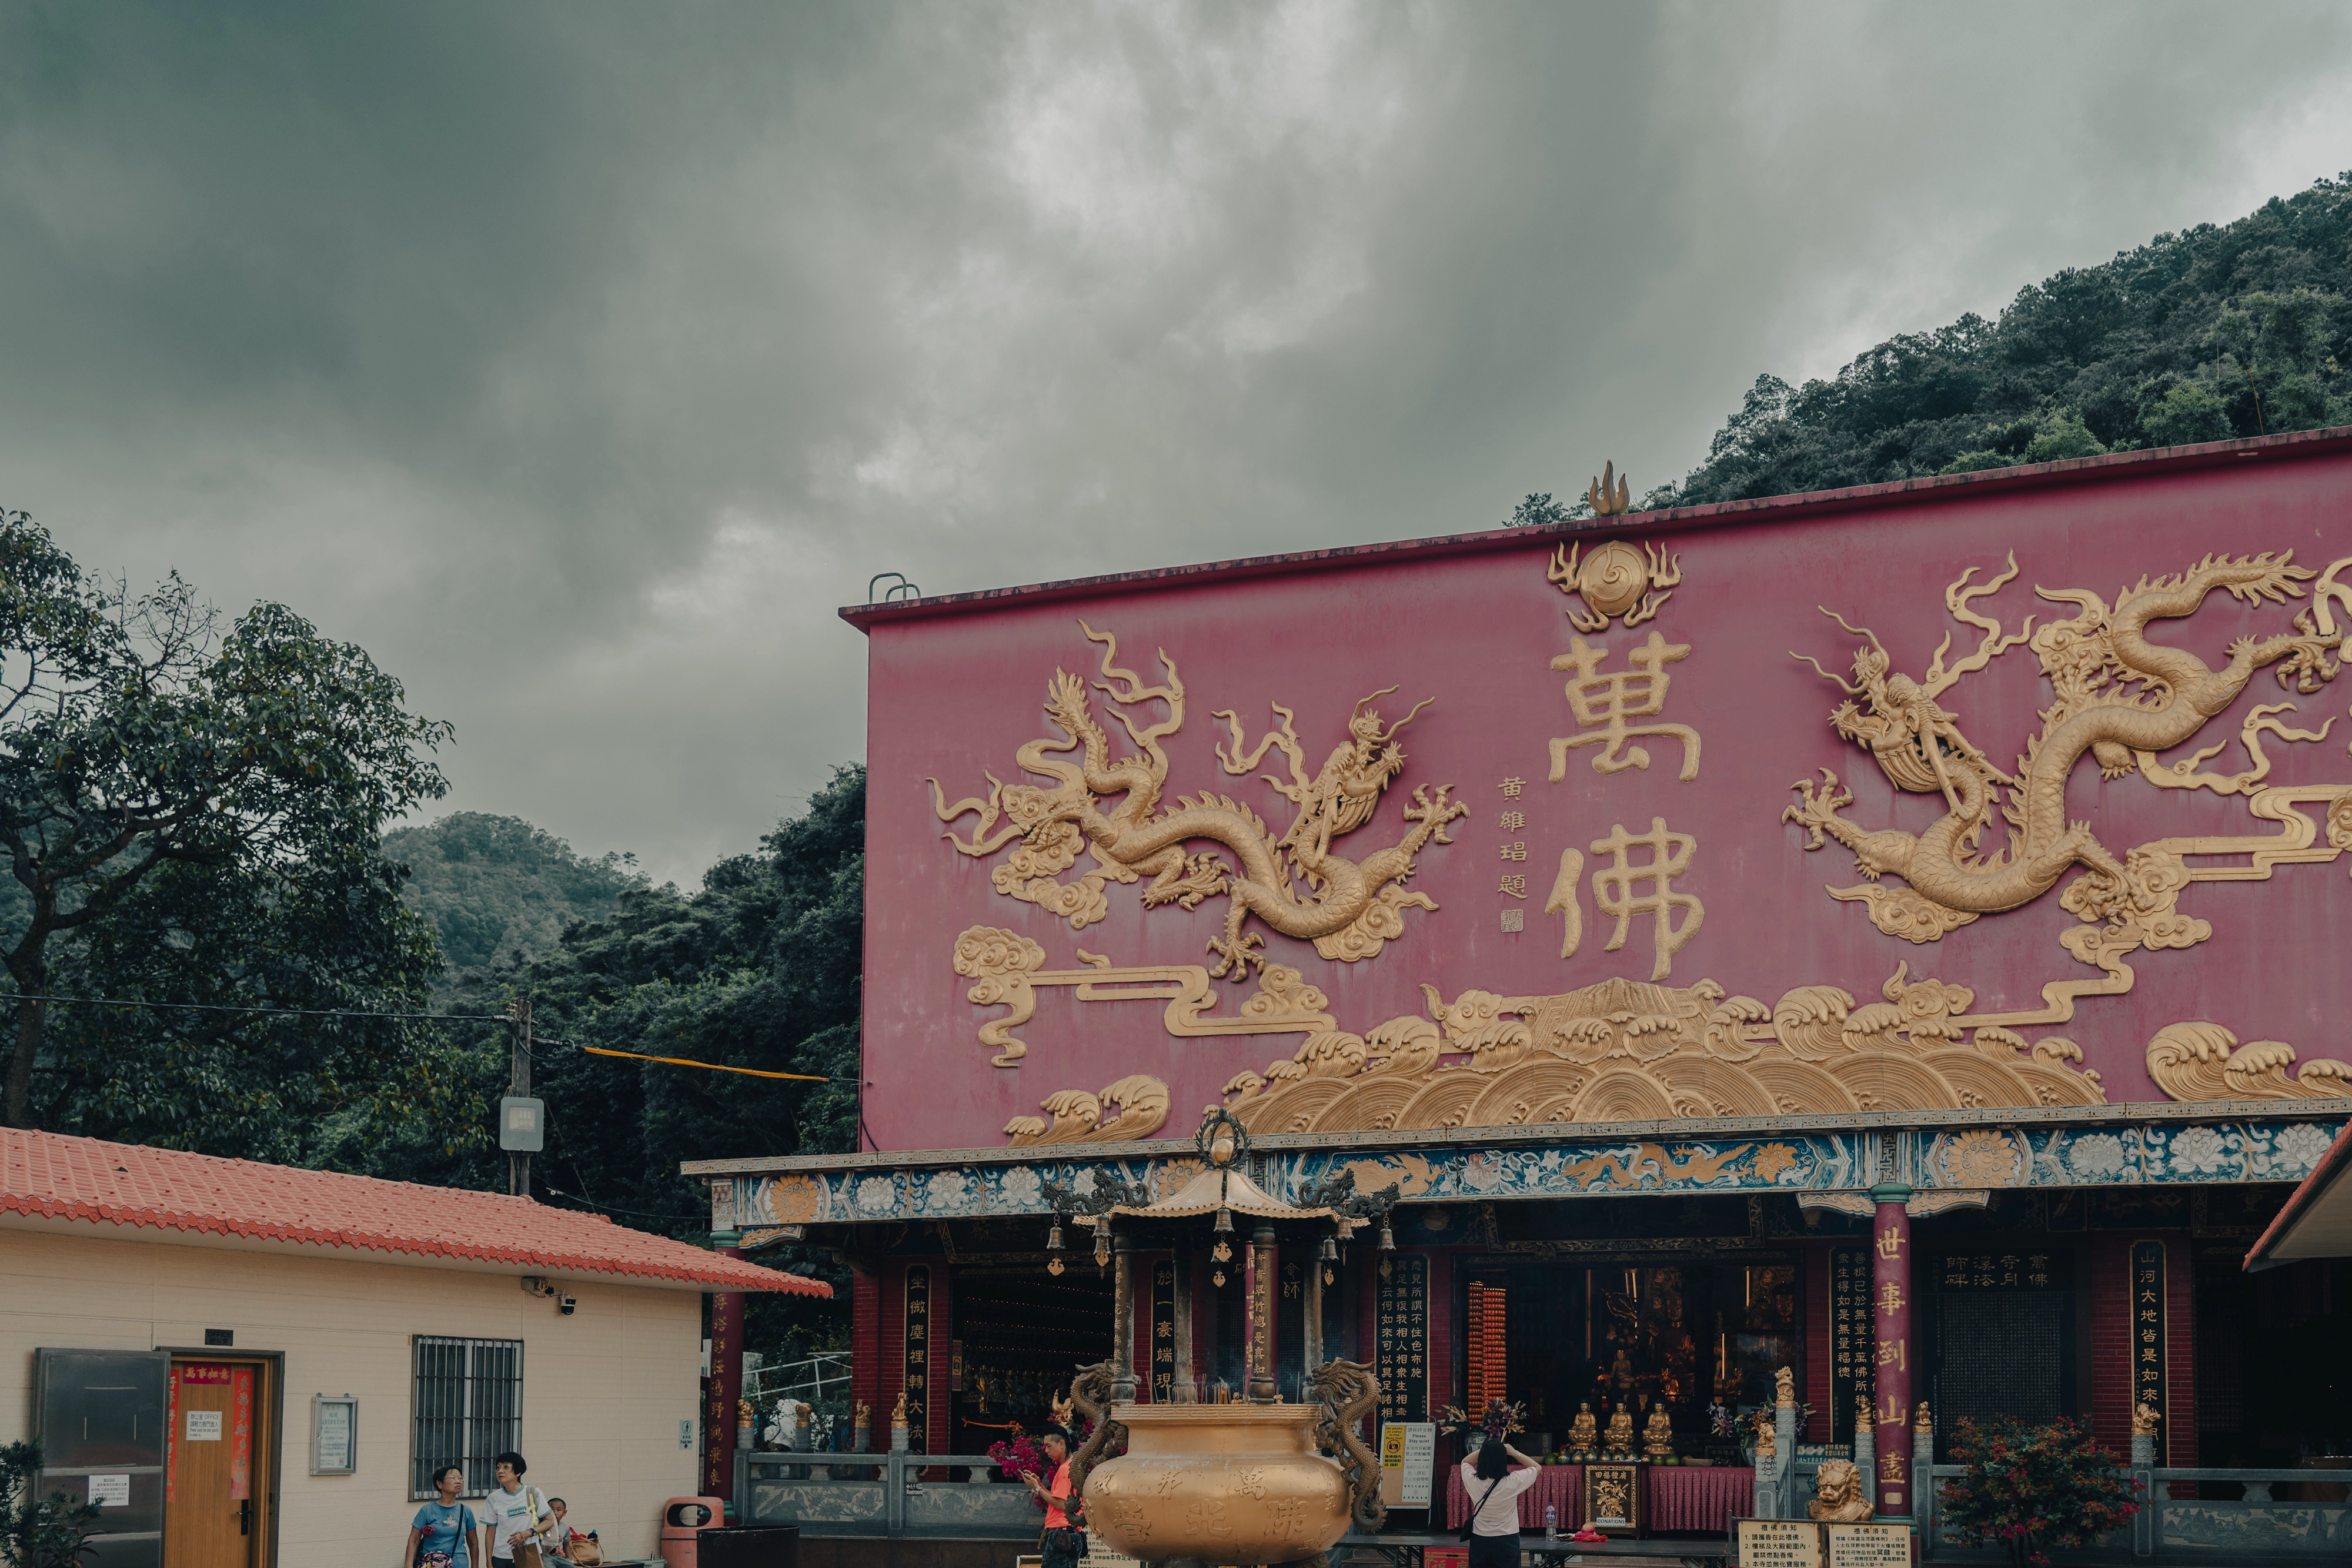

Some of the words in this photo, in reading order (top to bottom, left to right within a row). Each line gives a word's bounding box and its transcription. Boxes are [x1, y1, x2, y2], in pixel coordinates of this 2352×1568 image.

[1545, 631, 1704, 981] 萬佛
[185, 1367, 229, 1379] 萬事如意
[1381, 1261, 1393, 1422] 意云何如來可以具足諸相
[1396, 1261, 1408, 1422] 具足無復我相人相衆生相壽
[2140, 1251, 2159, 1461] 山河大地皆是如來
